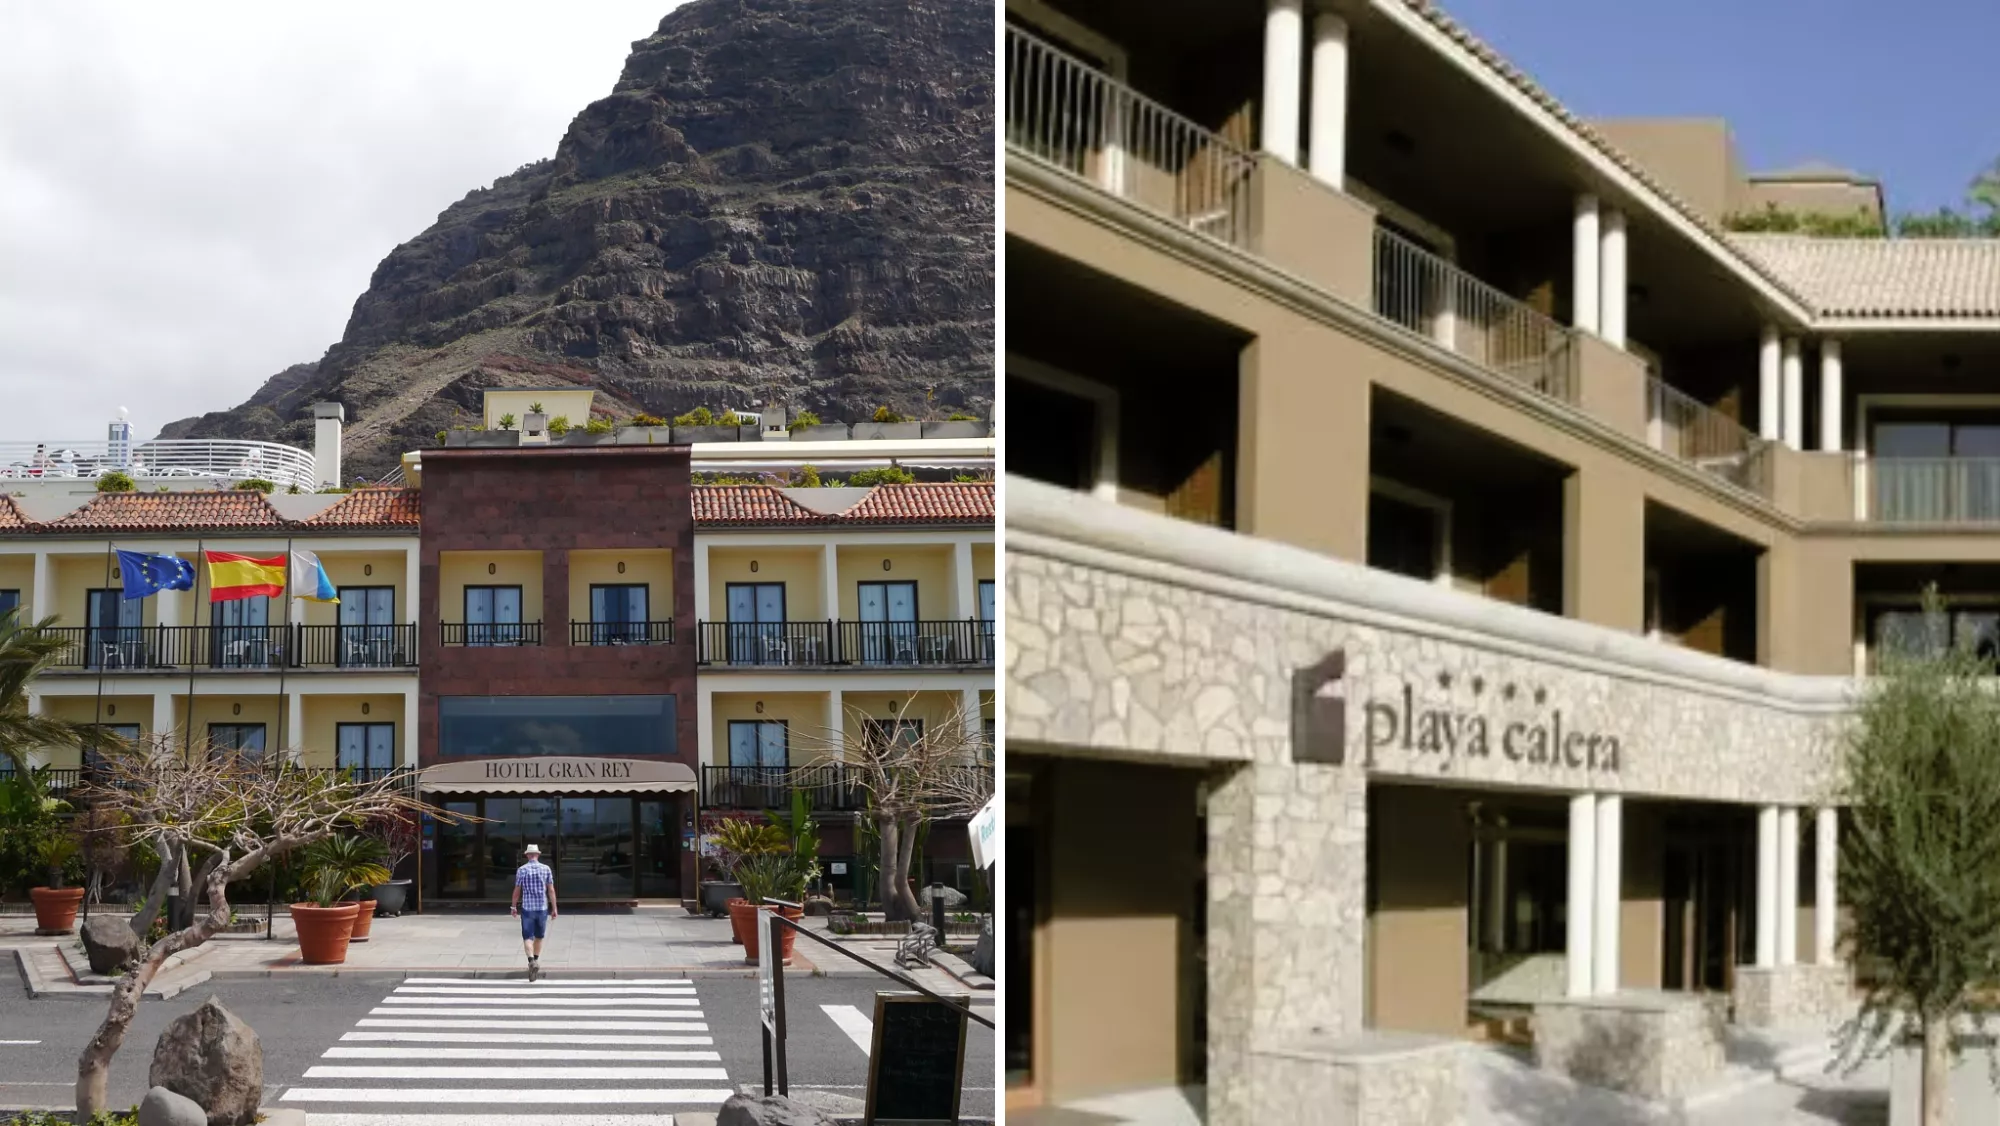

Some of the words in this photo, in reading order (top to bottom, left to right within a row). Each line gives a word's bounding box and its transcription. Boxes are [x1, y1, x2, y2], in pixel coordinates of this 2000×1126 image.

[1364, 682, 1489, 771] playa
[1502, 709, 1621, 771] calera
[485, 762, 545, 779] HOTEL
[548, 762, 596, 779] GRAN
[602, 762, 633, 778] REY
